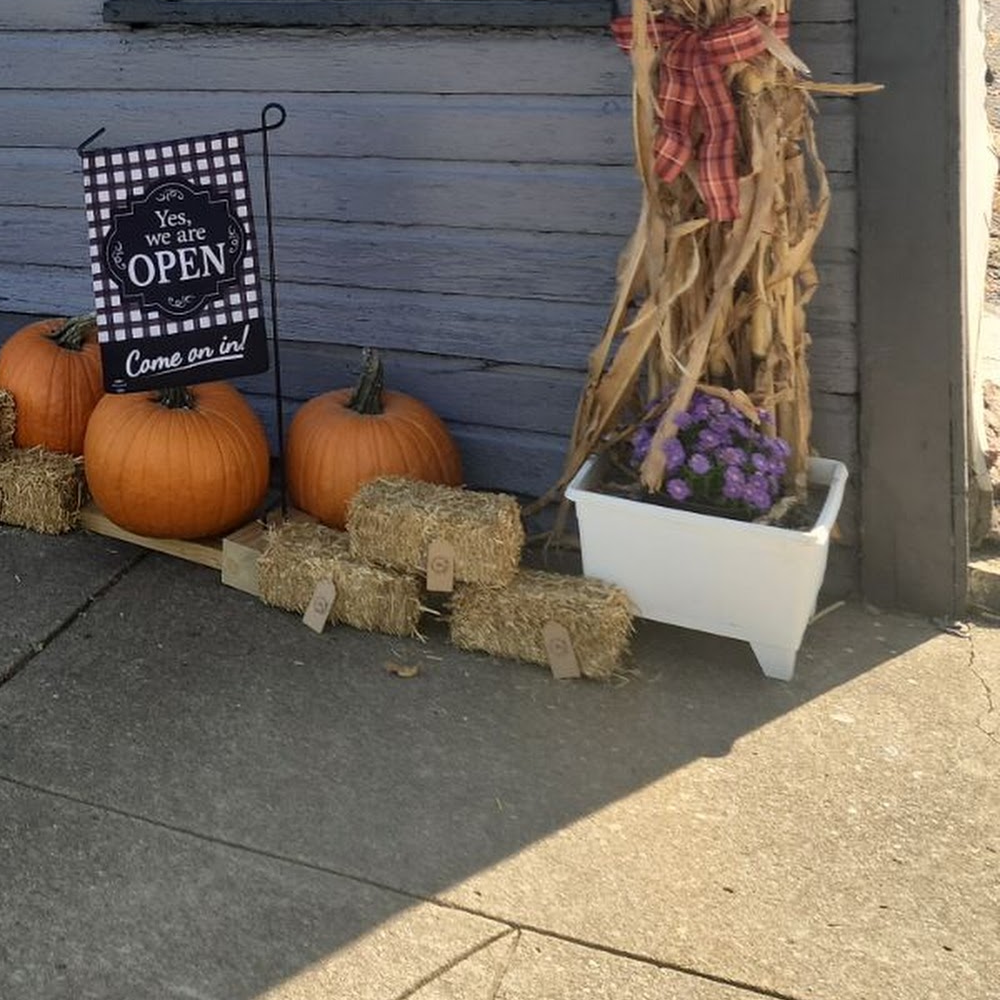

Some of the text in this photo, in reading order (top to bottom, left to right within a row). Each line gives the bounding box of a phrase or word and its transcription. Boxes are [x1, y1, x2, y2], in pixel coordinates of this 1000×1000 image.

[155, 210, 192, 228] Yes,
[145, 225, 206, 246] we are
[128, 243, 226, 287] OPEN
[125, 323, 250, 378] Come on in!
